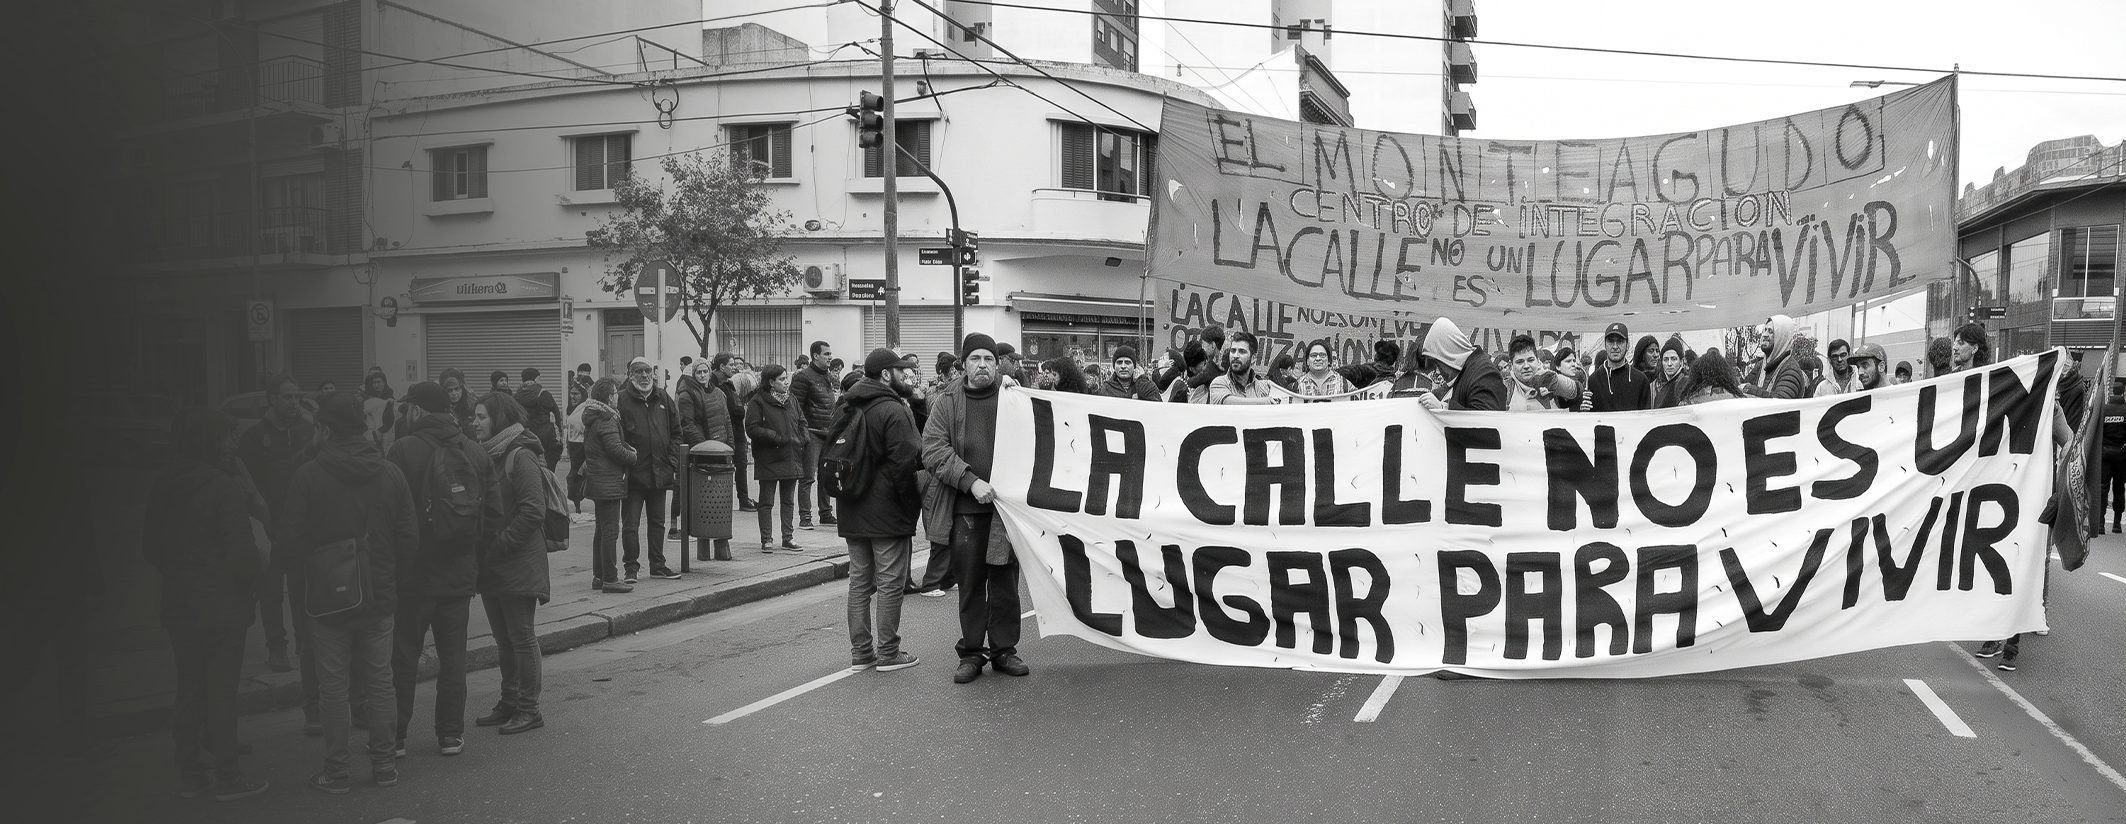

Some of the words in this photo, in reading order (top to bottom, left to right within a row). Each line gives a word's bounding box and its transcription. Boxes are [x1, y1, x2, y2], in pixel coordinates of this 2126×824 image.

[1208, 113, 1286, 173] EL
[1314, 103, 1874, 206] MONTEAGUDO
[1289, 188, 1434, 238] CENTRO
[1453, 204, 1496, 238] DE
[1431, 238, 1465, 266] NO
[1453, 275, 1487, 307] ES
[1486, 246, 1523, 274] UN
[1525, 229, 1693, 308] LUGAR
[1694, 229, 1772, 282] PARA
[1027, 397, 1145, 519] LA
[1177, 425, 1502, 527] CALLE
[1543, 423, 1717, 531] NO
[1743, 395, 1878, 514] ES
[1915, 350, 2060, 475] UN
[1058, 534, 1394, 663] LUGAR
[1438, 542, 1698, 665] PARA
[1719, 484, 2019, 632] VIVIR
